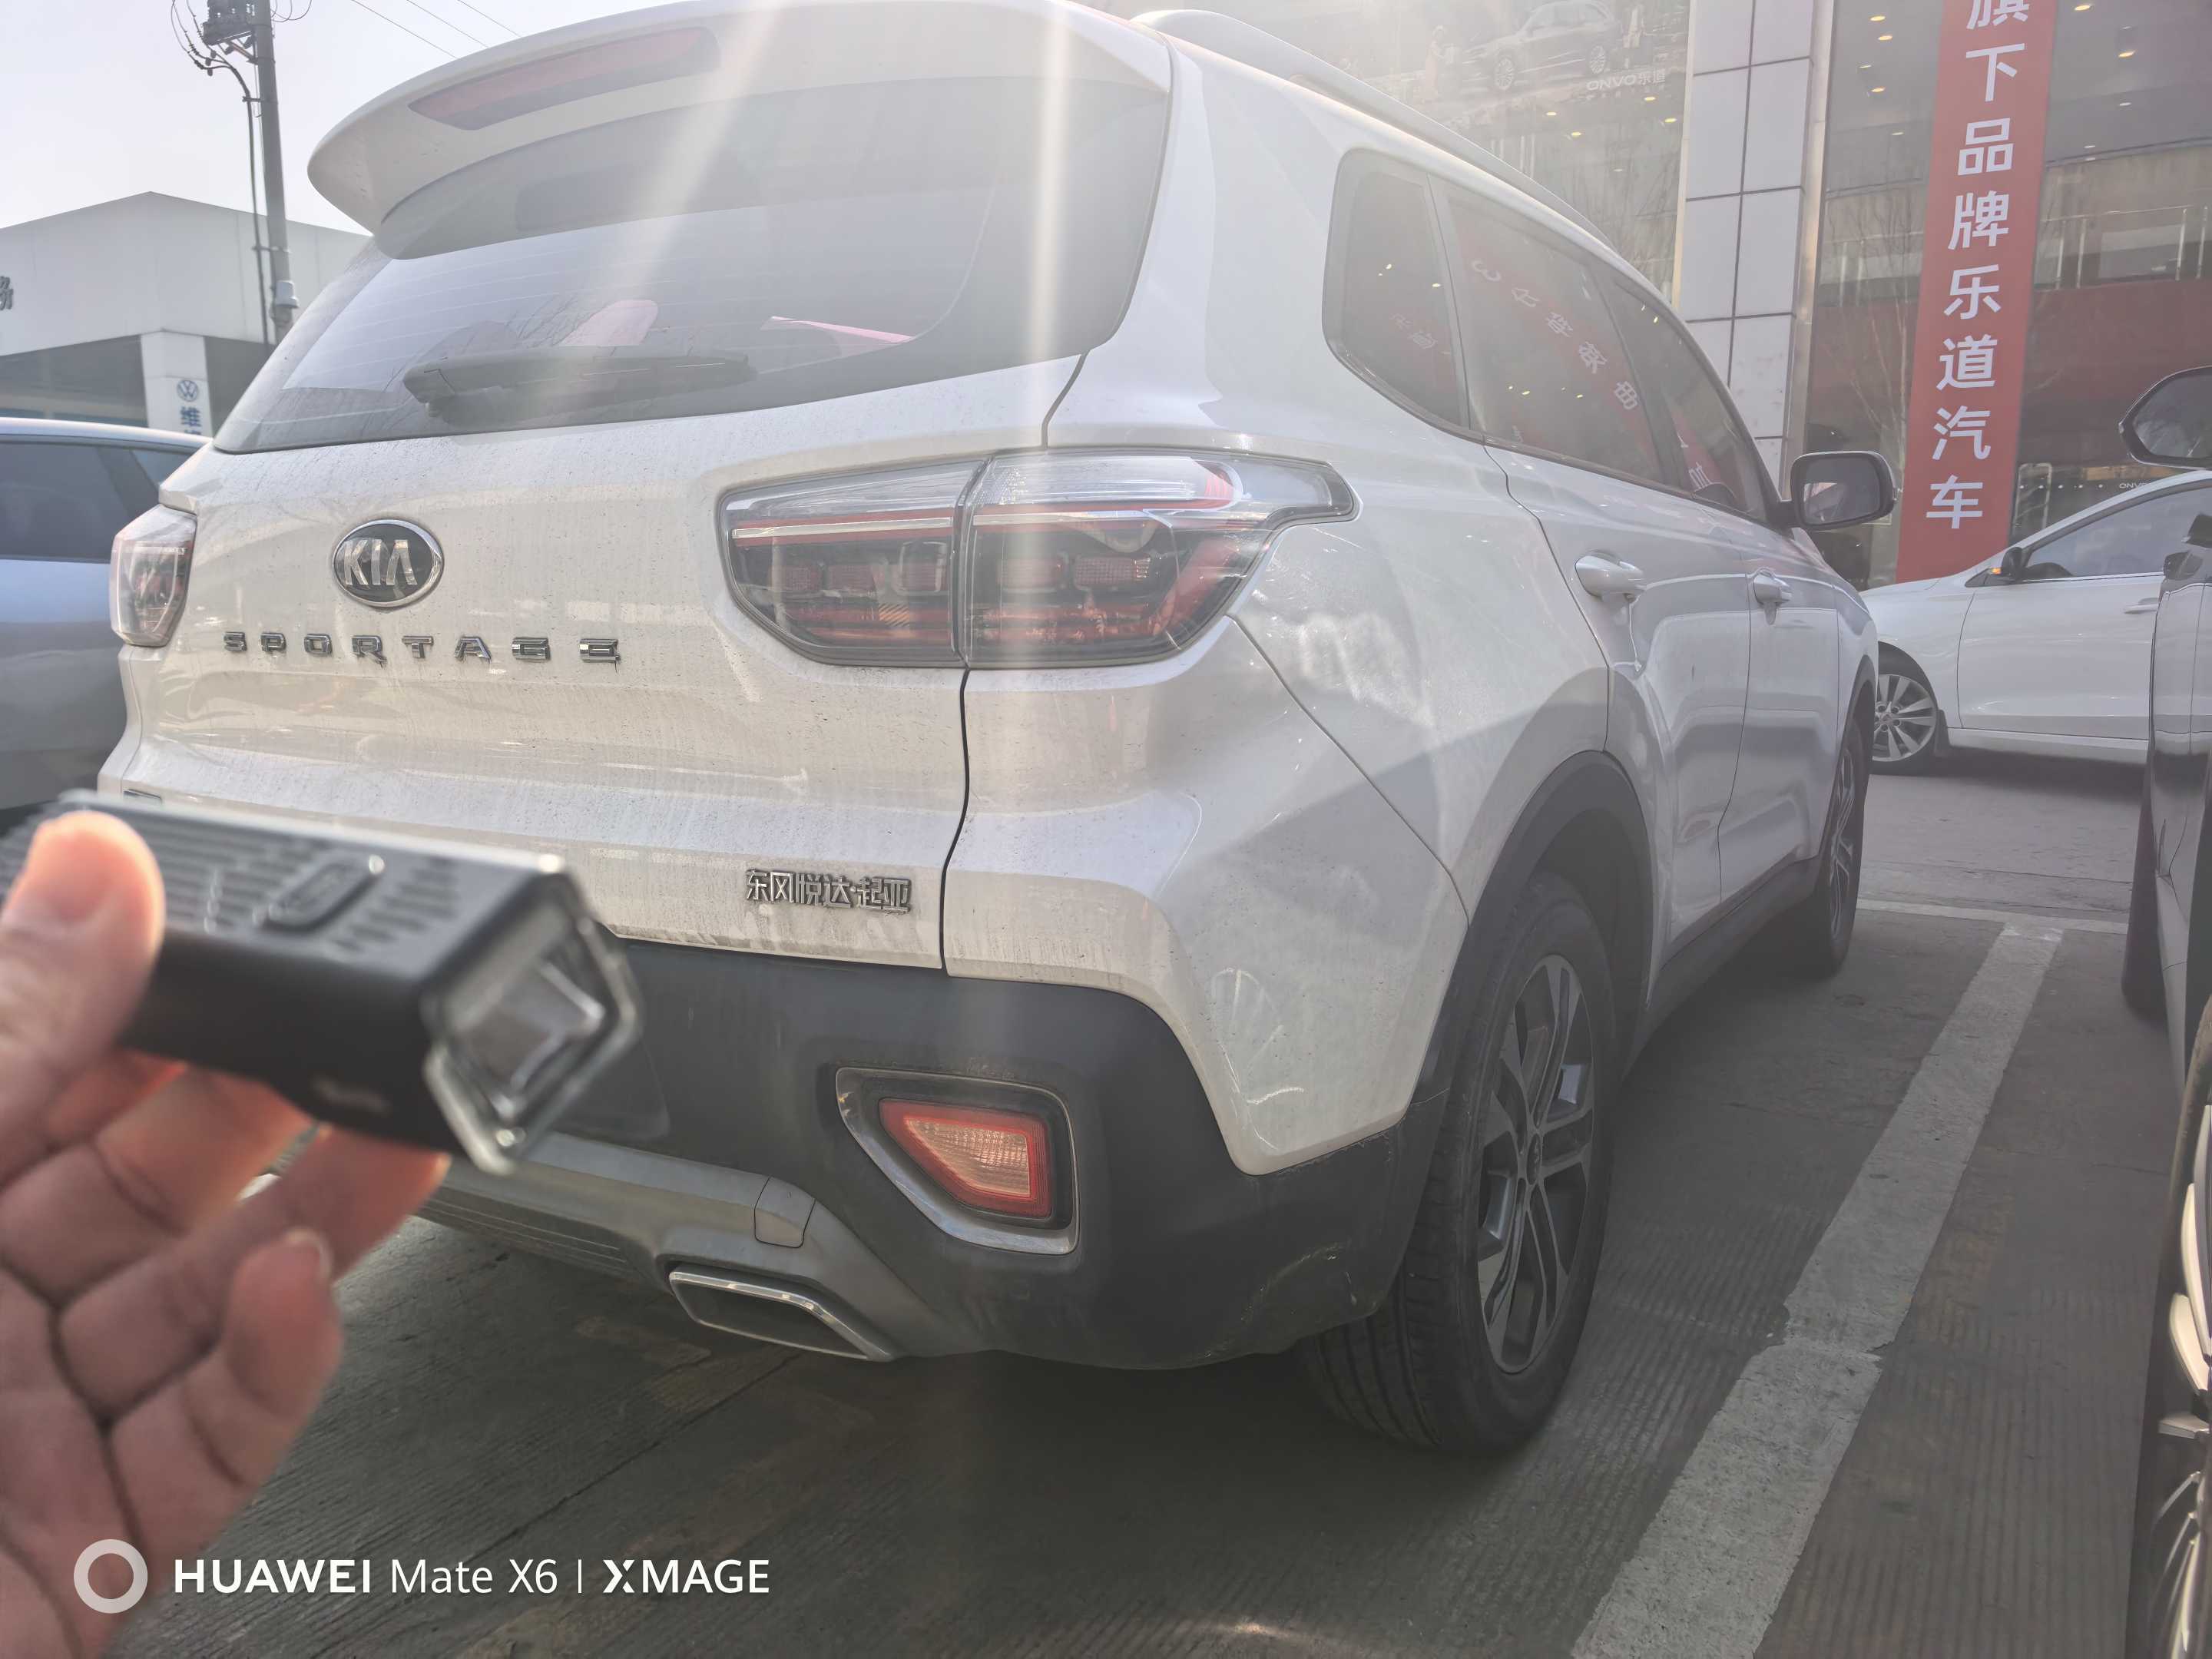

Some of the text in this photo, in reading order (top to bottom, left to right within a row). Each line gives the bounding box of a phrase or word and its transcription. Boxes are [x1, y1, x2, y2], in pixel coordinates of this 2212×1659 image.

[1586, 75, 1636, 91] ONVO
[343, 538, 418, 587] KIA
[224, 631, 620, 663] SPORTAGE
